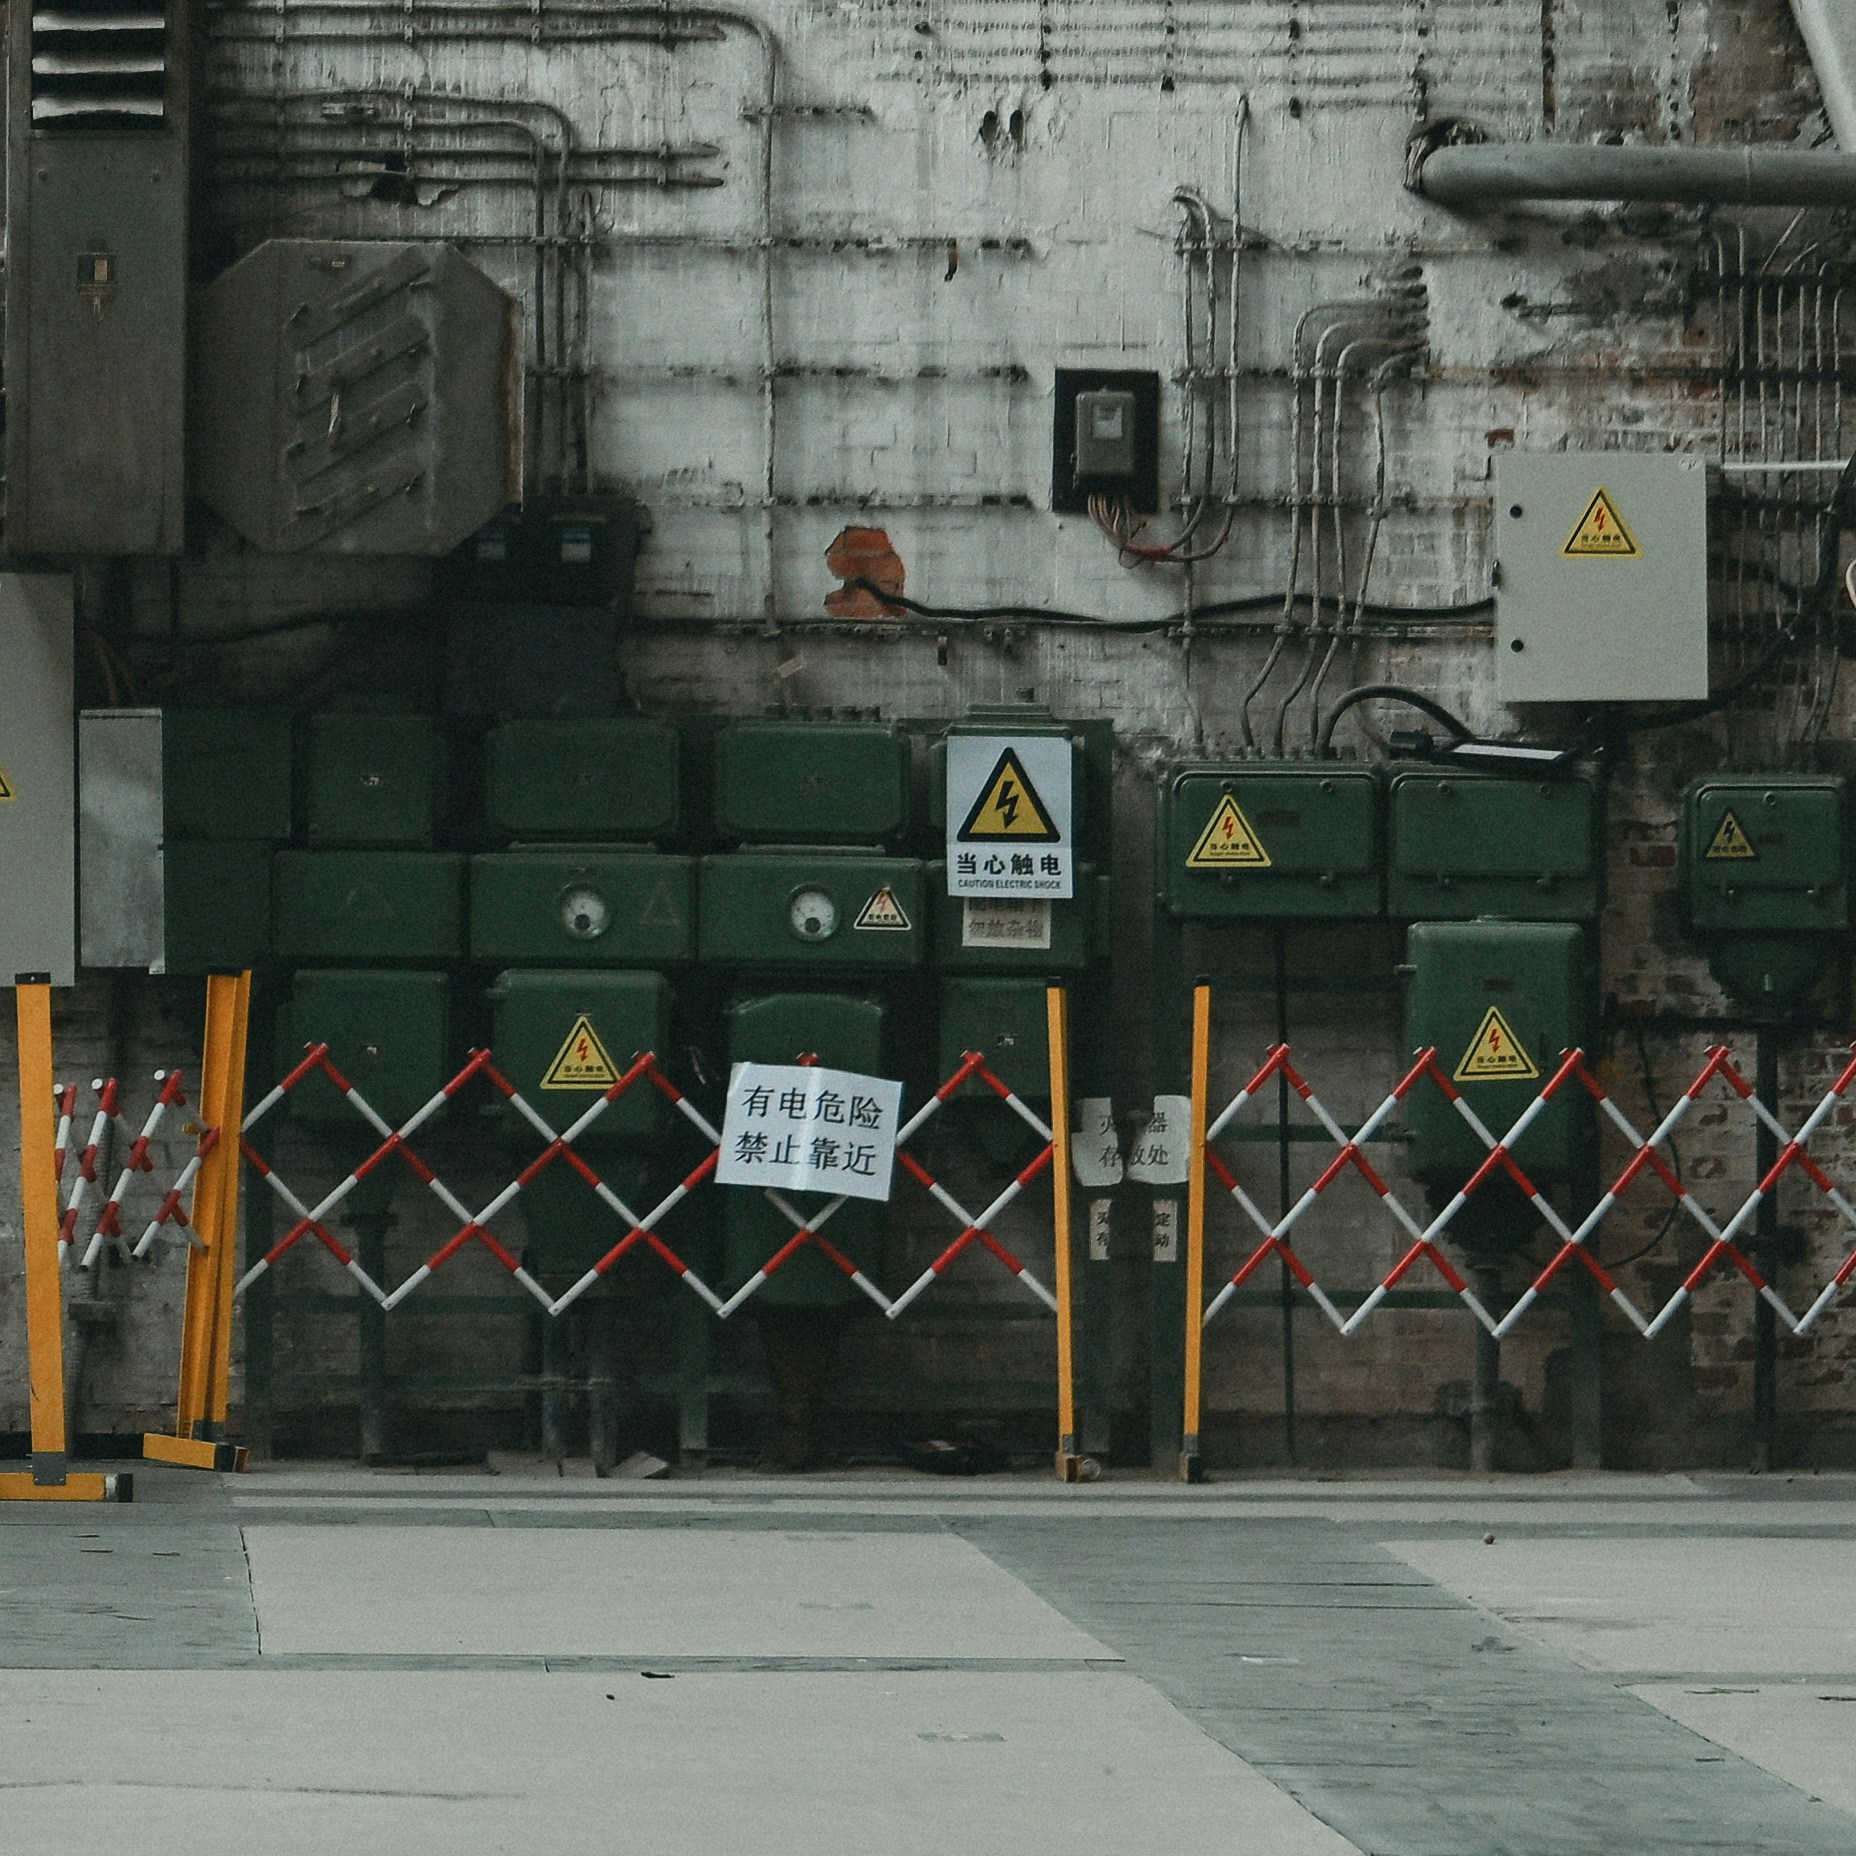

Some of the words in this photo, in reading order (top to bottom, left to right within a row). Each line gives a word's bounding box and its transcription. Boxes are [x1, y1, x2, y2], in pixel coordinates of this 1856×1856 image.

[956, 852, 1062, 876] 当心触电
[957, 879, 994, 888] CAUTION
[995, 879, 1033, 889] ELECTRIC
[1034, 880, 1061, 890] SHOCK
[741, 1084, 883, 1130] 有电危险
[734, 1130, 876, 1177] 禁止靠近
